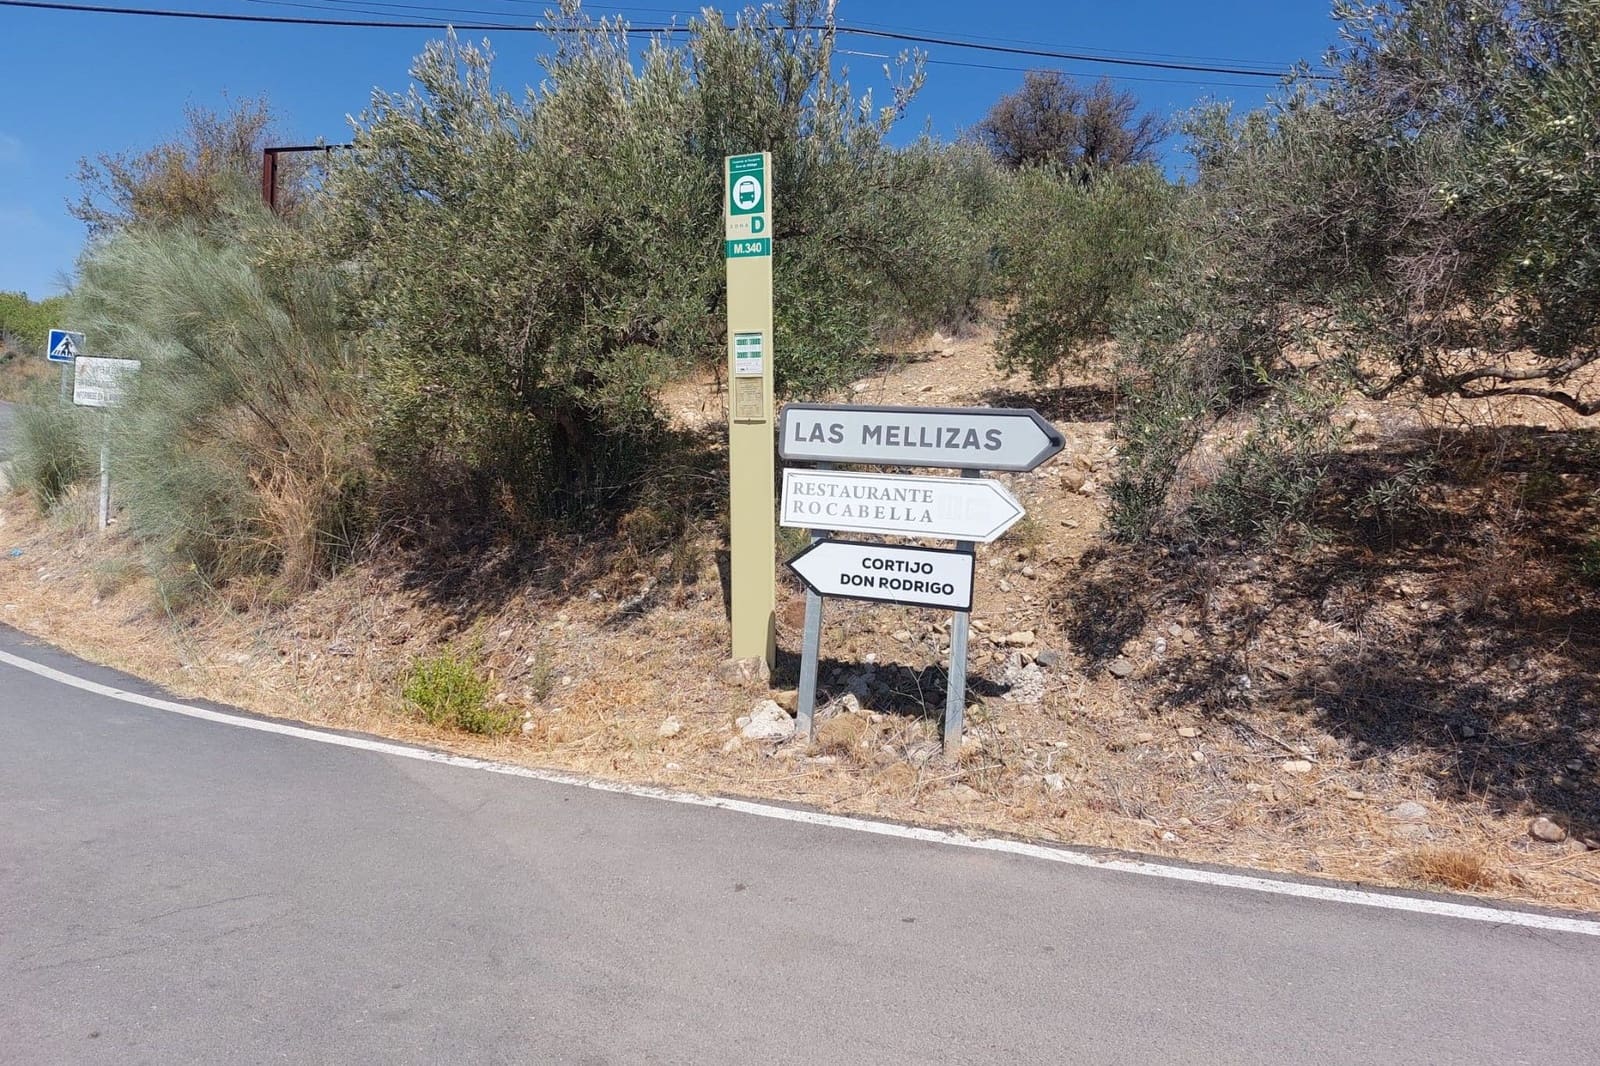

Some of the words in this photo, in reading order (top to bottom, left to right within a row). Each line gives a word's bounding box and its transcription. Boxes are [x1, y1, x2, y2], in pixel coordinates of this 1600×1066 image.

[751, 216, 765, 233] D
[733, 242, 762, 254] M.340
[794, 422, 844, 444] LAS
[861, 424, 1003, 451] MELLIZAS
[793, 481, 934, 504] RESTAURANTE
[792, 500, 934, 523] ROCABELLA
[862, 557, 933, 575] CORTIJO
[840, 573, 875, 588] DON
[879, 577, 955, 596] RODRIGO
